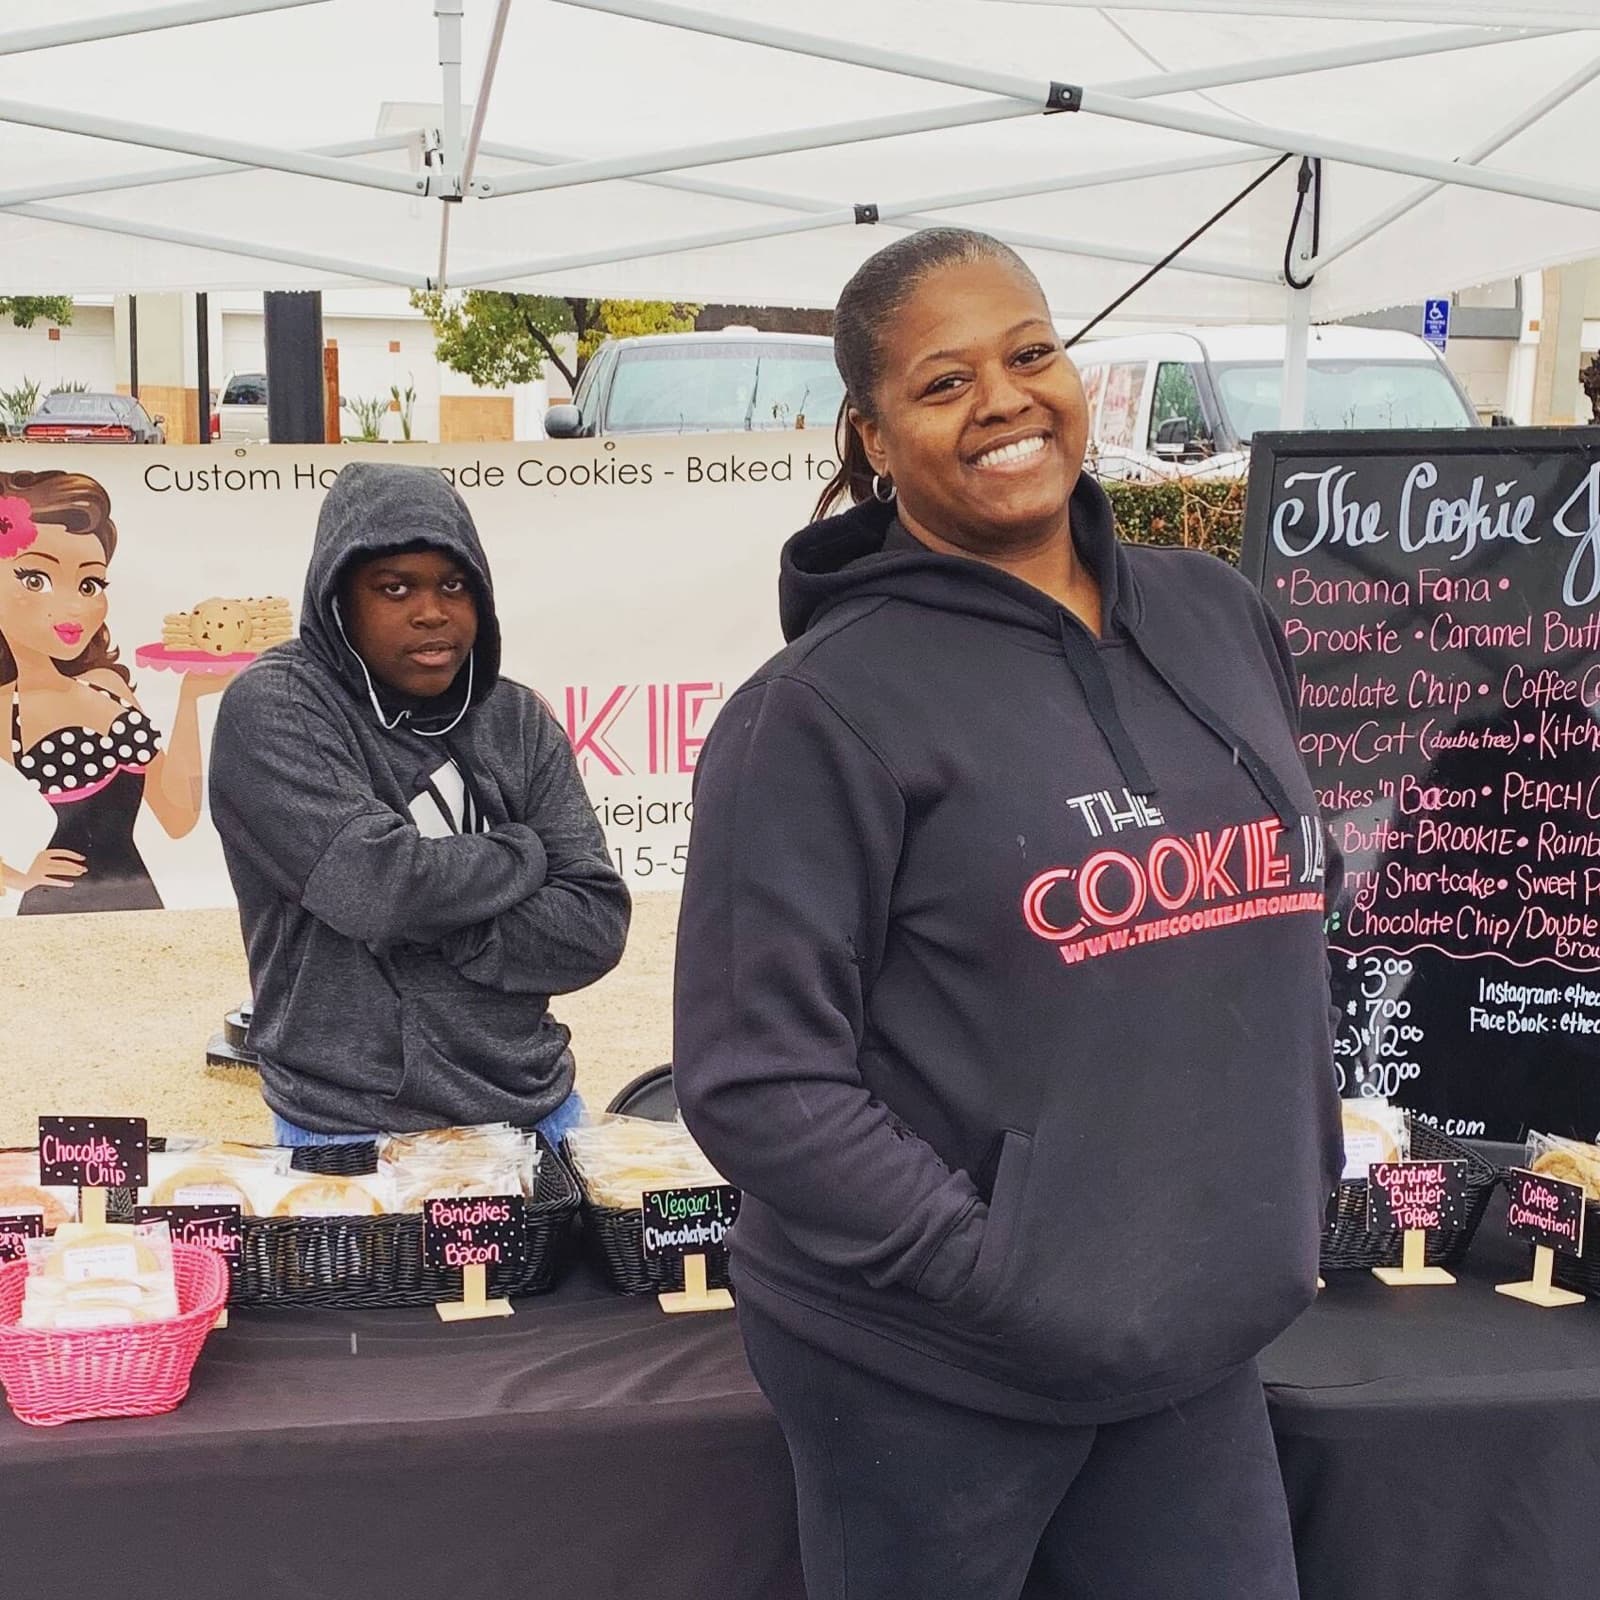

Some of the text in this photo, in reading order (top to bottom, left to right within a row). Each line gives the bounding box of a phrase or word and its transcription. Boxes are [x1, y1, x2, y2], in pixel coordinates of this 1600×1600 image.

[144, 463, 281, 492] Custom
[293, 460, 504, 490] Hoade
[518, 458, 653, 487] Cookies
[687, 453, 792, 483] Baked
[804, 453, 838, 481] to
[1272, 464, 1389, 558] The
[1399, 461, 1541, 561] Cookie
[1290, 568, 1492, 606] Banana Fana
[1284, 618, 1402, 656] Brookie
[1429, 612, 1532, 652] Caramel
[1300, 673, 1399, 708] hocolate
[1408, 669, 1471, 715] Chip
[1502, 664, 1577, 709] Coffee
[566, 682, 722, 777] KIE
[1300, 720, 1415, 767] opyCat
[1400, 774, 1477, 815] Bacon
[1502, 771, 1582, 815] PEACH
[1066, 787, 1165, 837] THE
[1342, 819, 1414, 853] Butter
[1418, 819, 1516, 855] BROOKIE
[1023, 817, 1290, 941] COOKIE
[1385, 861, 1497, 899] Shortcake
[1515, 863, 1577, 901] Sweet
[1347, 905, 1453, 937] Chocolate
[42, 1135, 119, 1165] Chocolate
[86, 1160, 127, 1186] Chip
[1377, 1164, 1447, 1187] Caramel
[431, 1201, 511, 1226] Pancakes
[1391, 1185, 1446, 1207] Butter
[1522, 1181, 1559, 1211] Coffee
[1391, 1207, 1440, 1228] Toffee
[445, 1243, 500, 1265] Bacon
[645, 1223, 710, 1250] Chocolate
